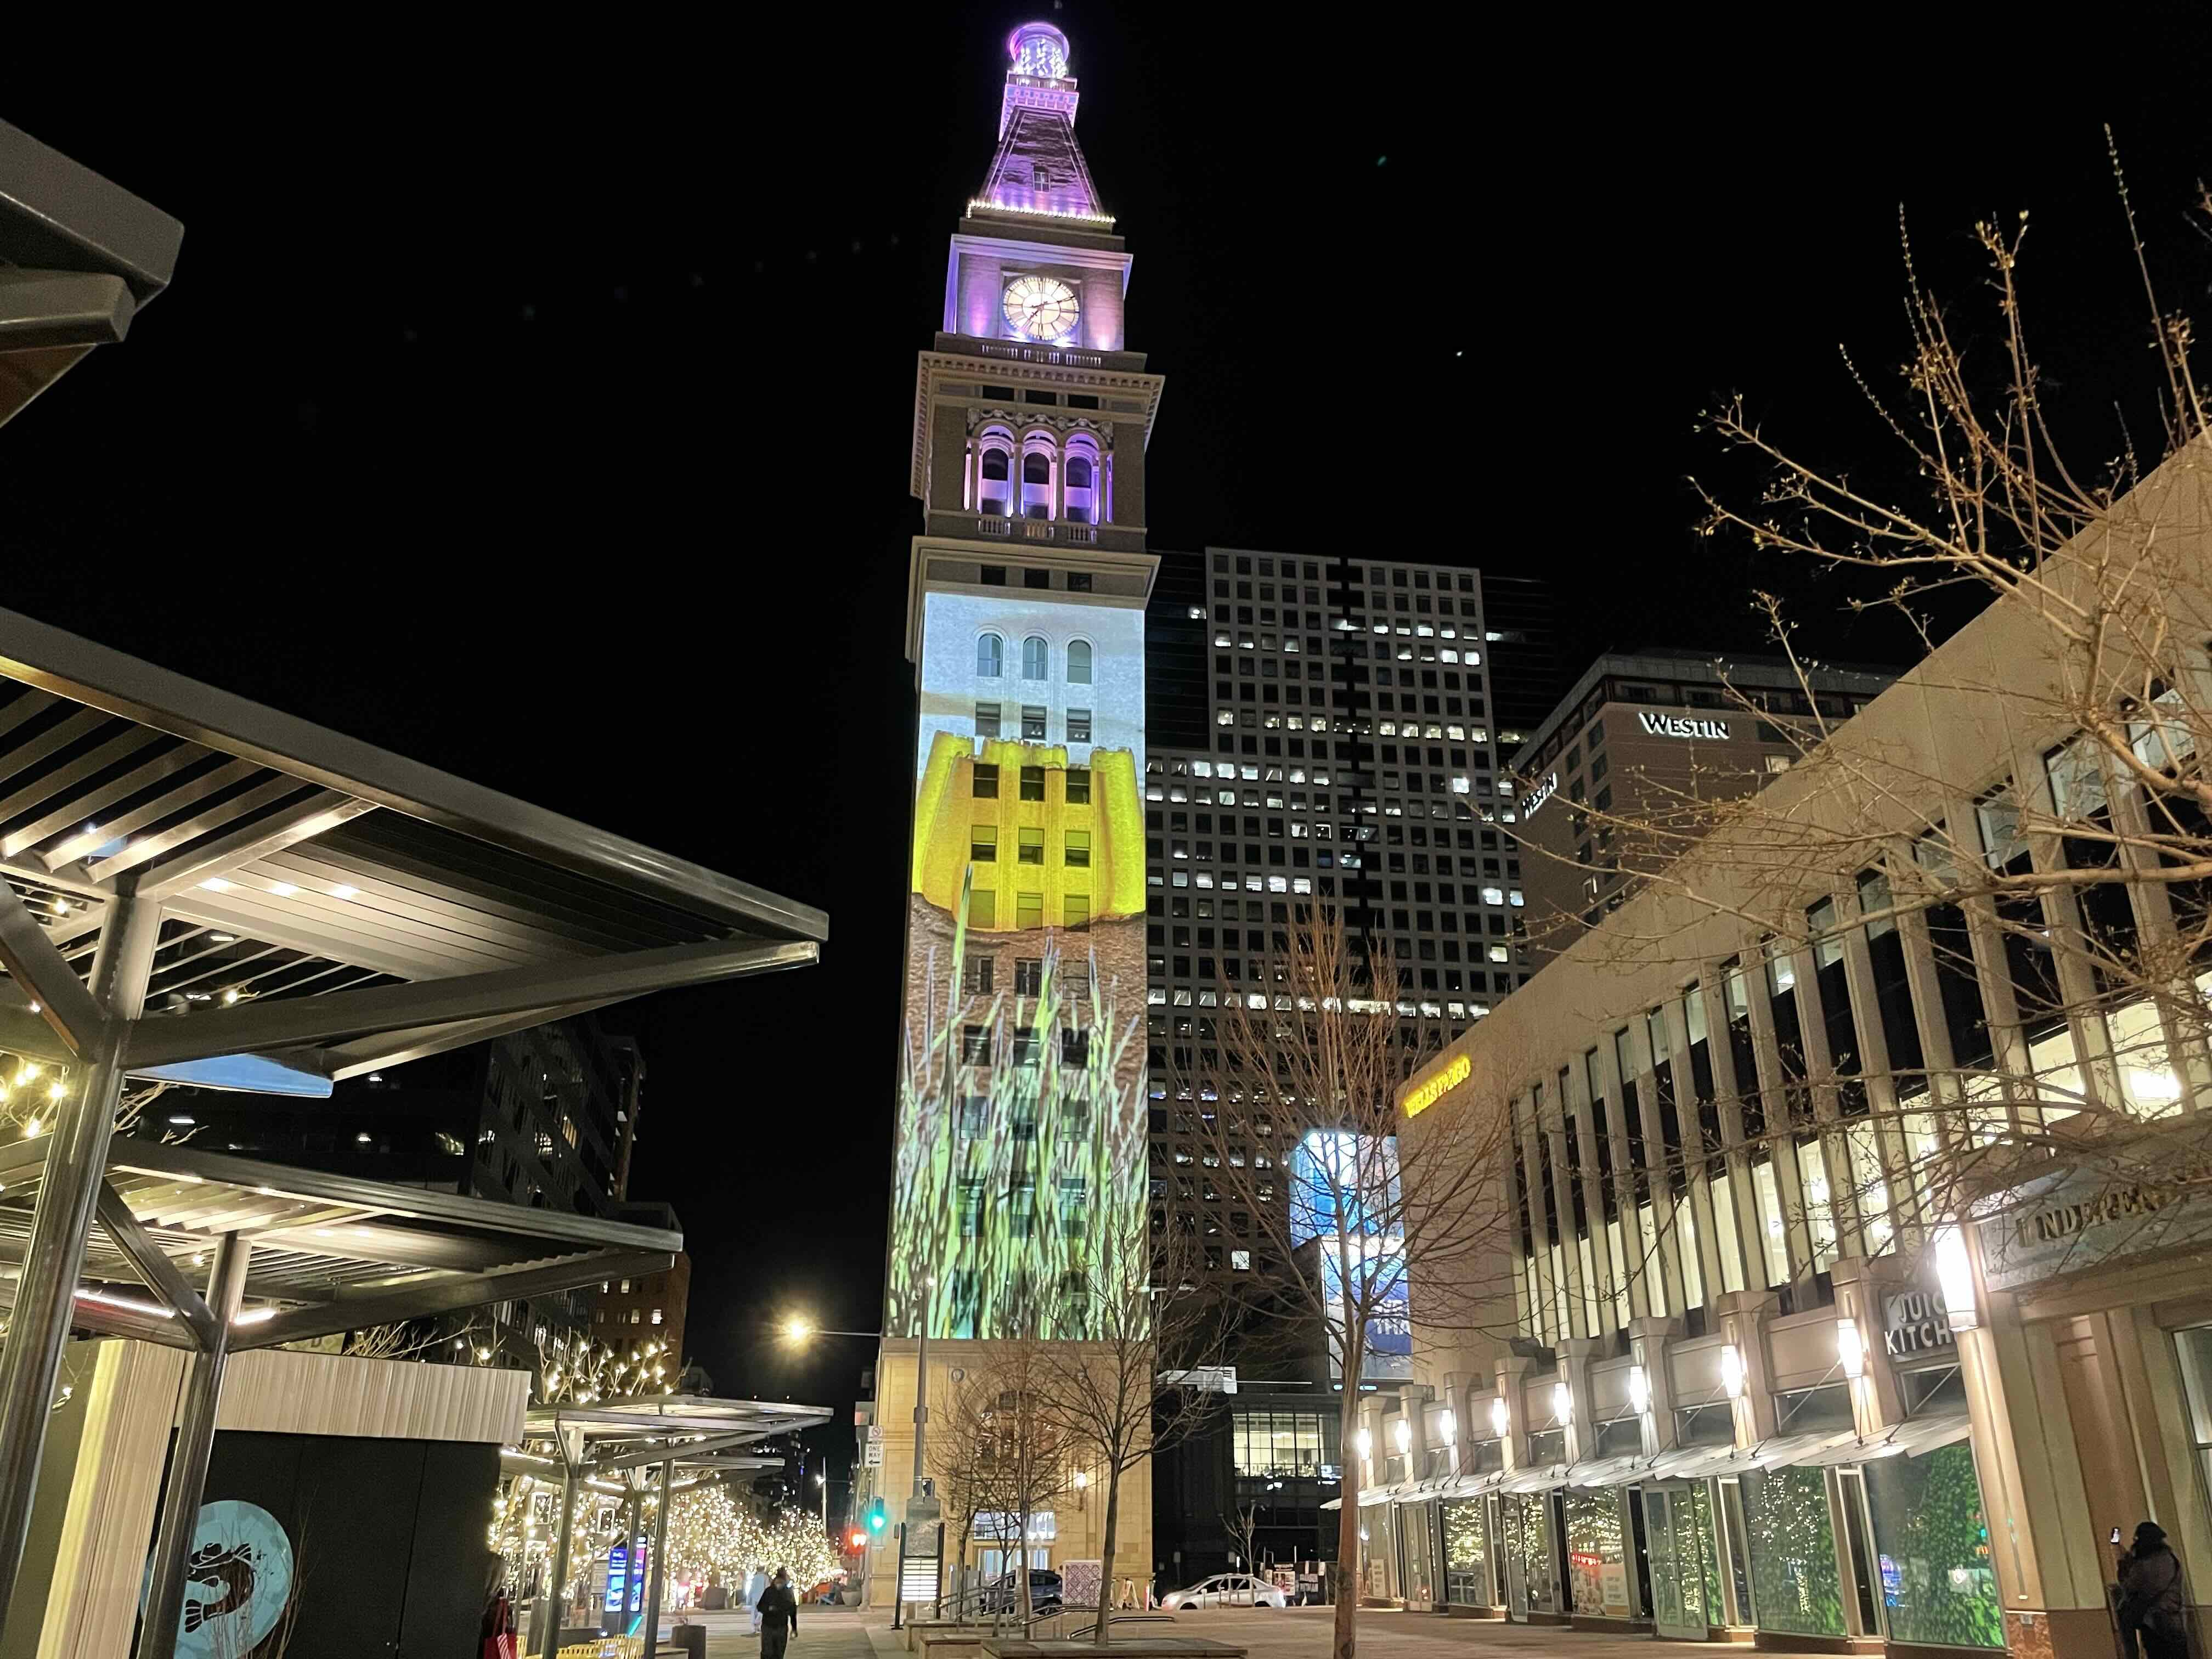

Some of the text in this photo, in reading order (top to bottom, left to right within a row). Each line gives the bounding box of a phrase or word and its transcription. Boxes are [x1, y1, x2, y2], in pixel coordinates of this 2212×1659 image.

[1638, 712, 1730, 740] WESTIN
[1899, 1291, 1948, 1323] JUIC
[1884, 1318, 1951, 1355] KITCH
